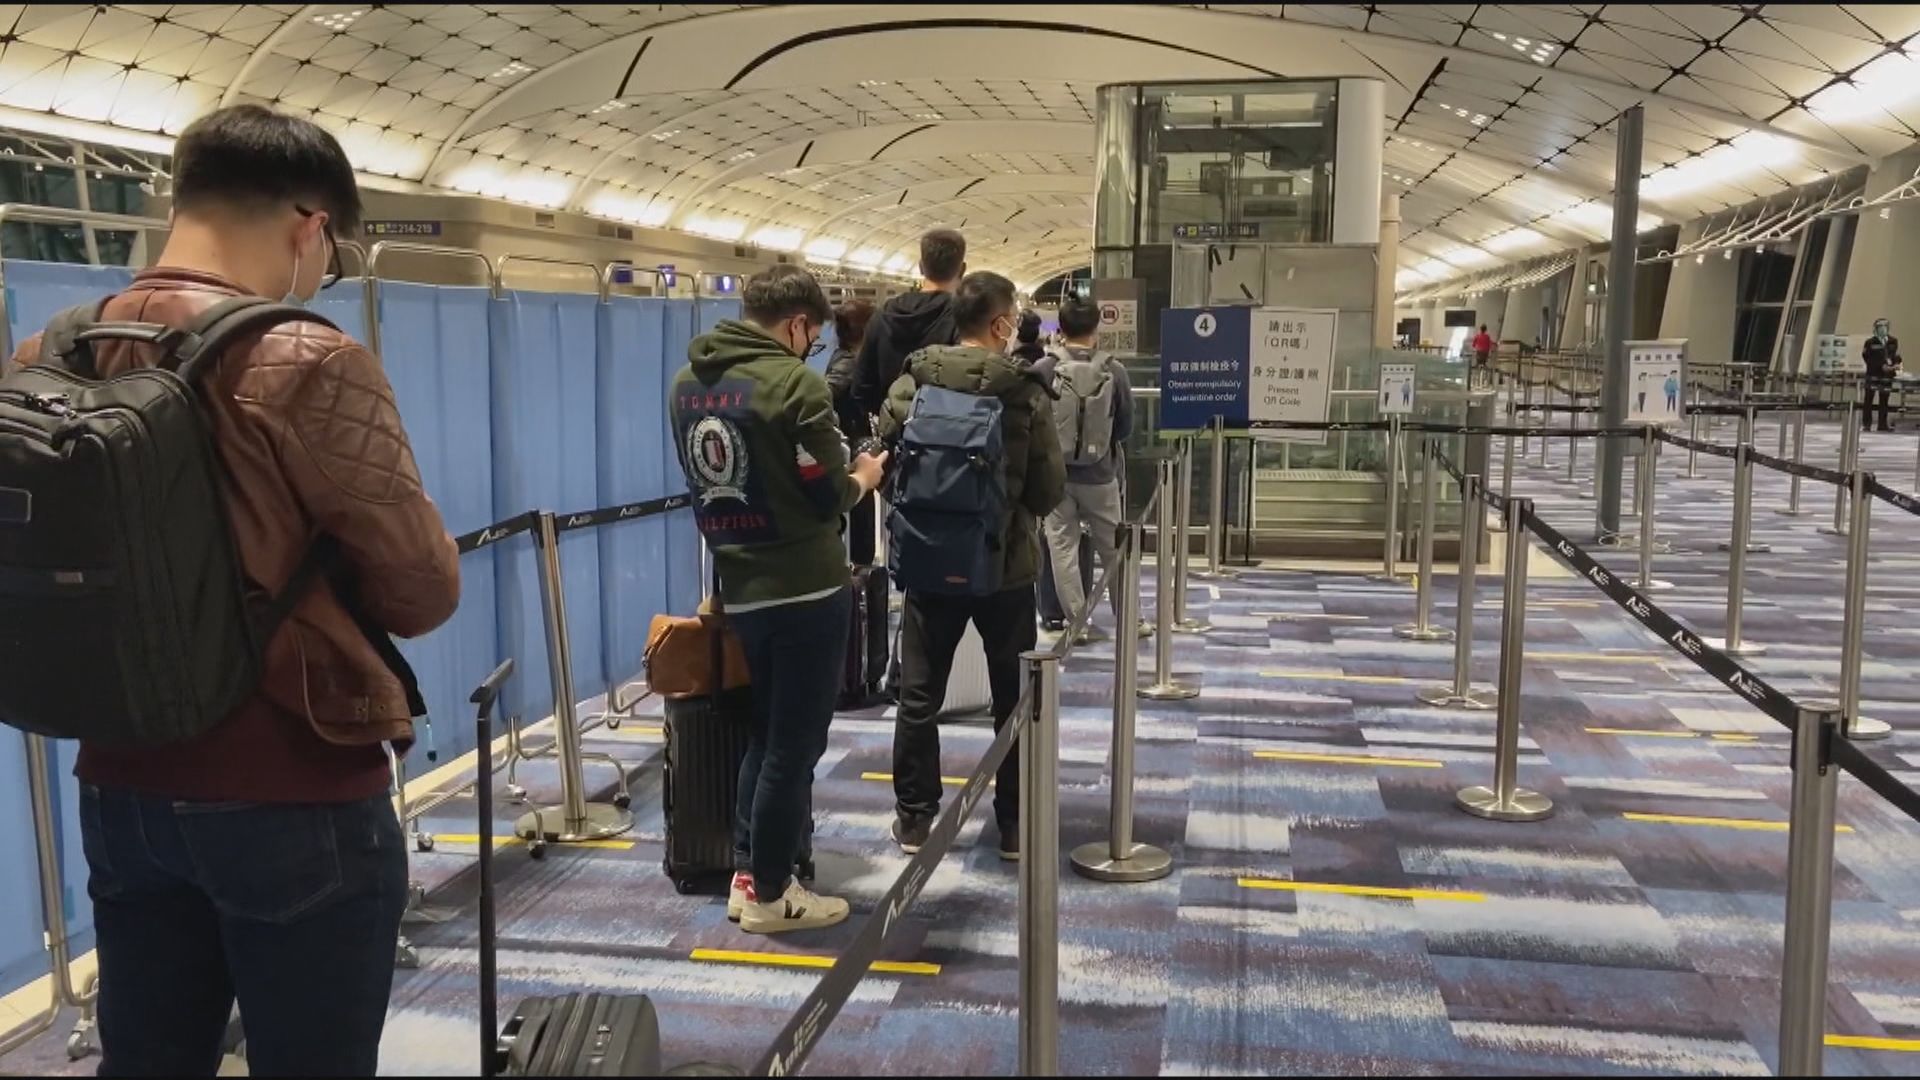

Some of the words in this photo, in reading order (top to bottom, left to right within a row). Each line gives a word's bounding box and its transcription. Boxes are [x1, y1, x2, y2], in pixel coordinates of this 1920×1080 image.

[1199, 317, 1210, 332] 4
[1168, 380, 1194, 389] Obtain
[1267, 384, 1299, 395] Present
[680, 391, 742, 409] TOMMY
[1172, 393, 1214, 403] quarantine
[1215, 393, 1237, 401] order
[1264, 396, 1277, 405] QR
[1279, 397, 1301, 406] Code
